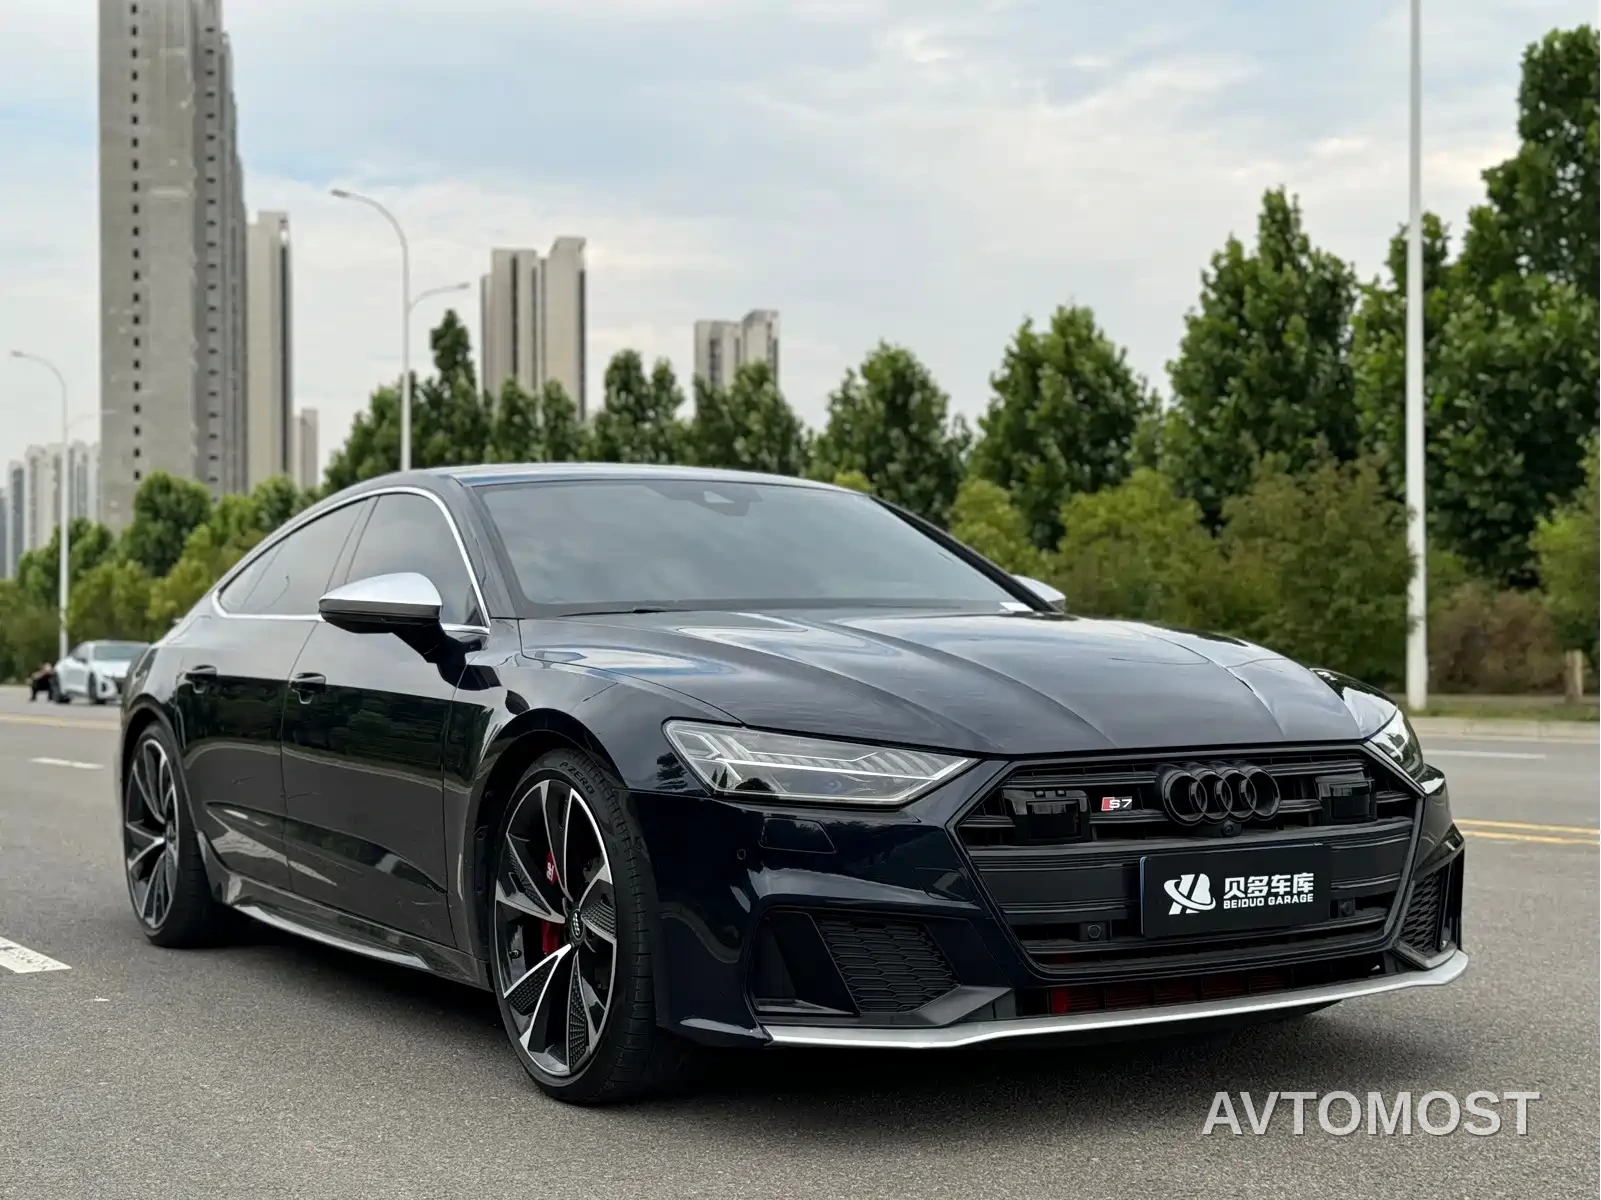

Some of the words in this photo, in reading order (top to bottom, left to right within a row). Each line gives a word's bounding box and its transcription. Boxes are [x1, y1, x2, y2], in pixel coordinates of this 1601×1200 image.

[567, 765, 596, 795] ZERO
[1107, 797, 1133, 809] S7
[1223, 872, 1314, 899] 贝多车库
[1223, 898, 1265, 910] BEIDUO
[1268, 893, 1314, 906] GARAGE
